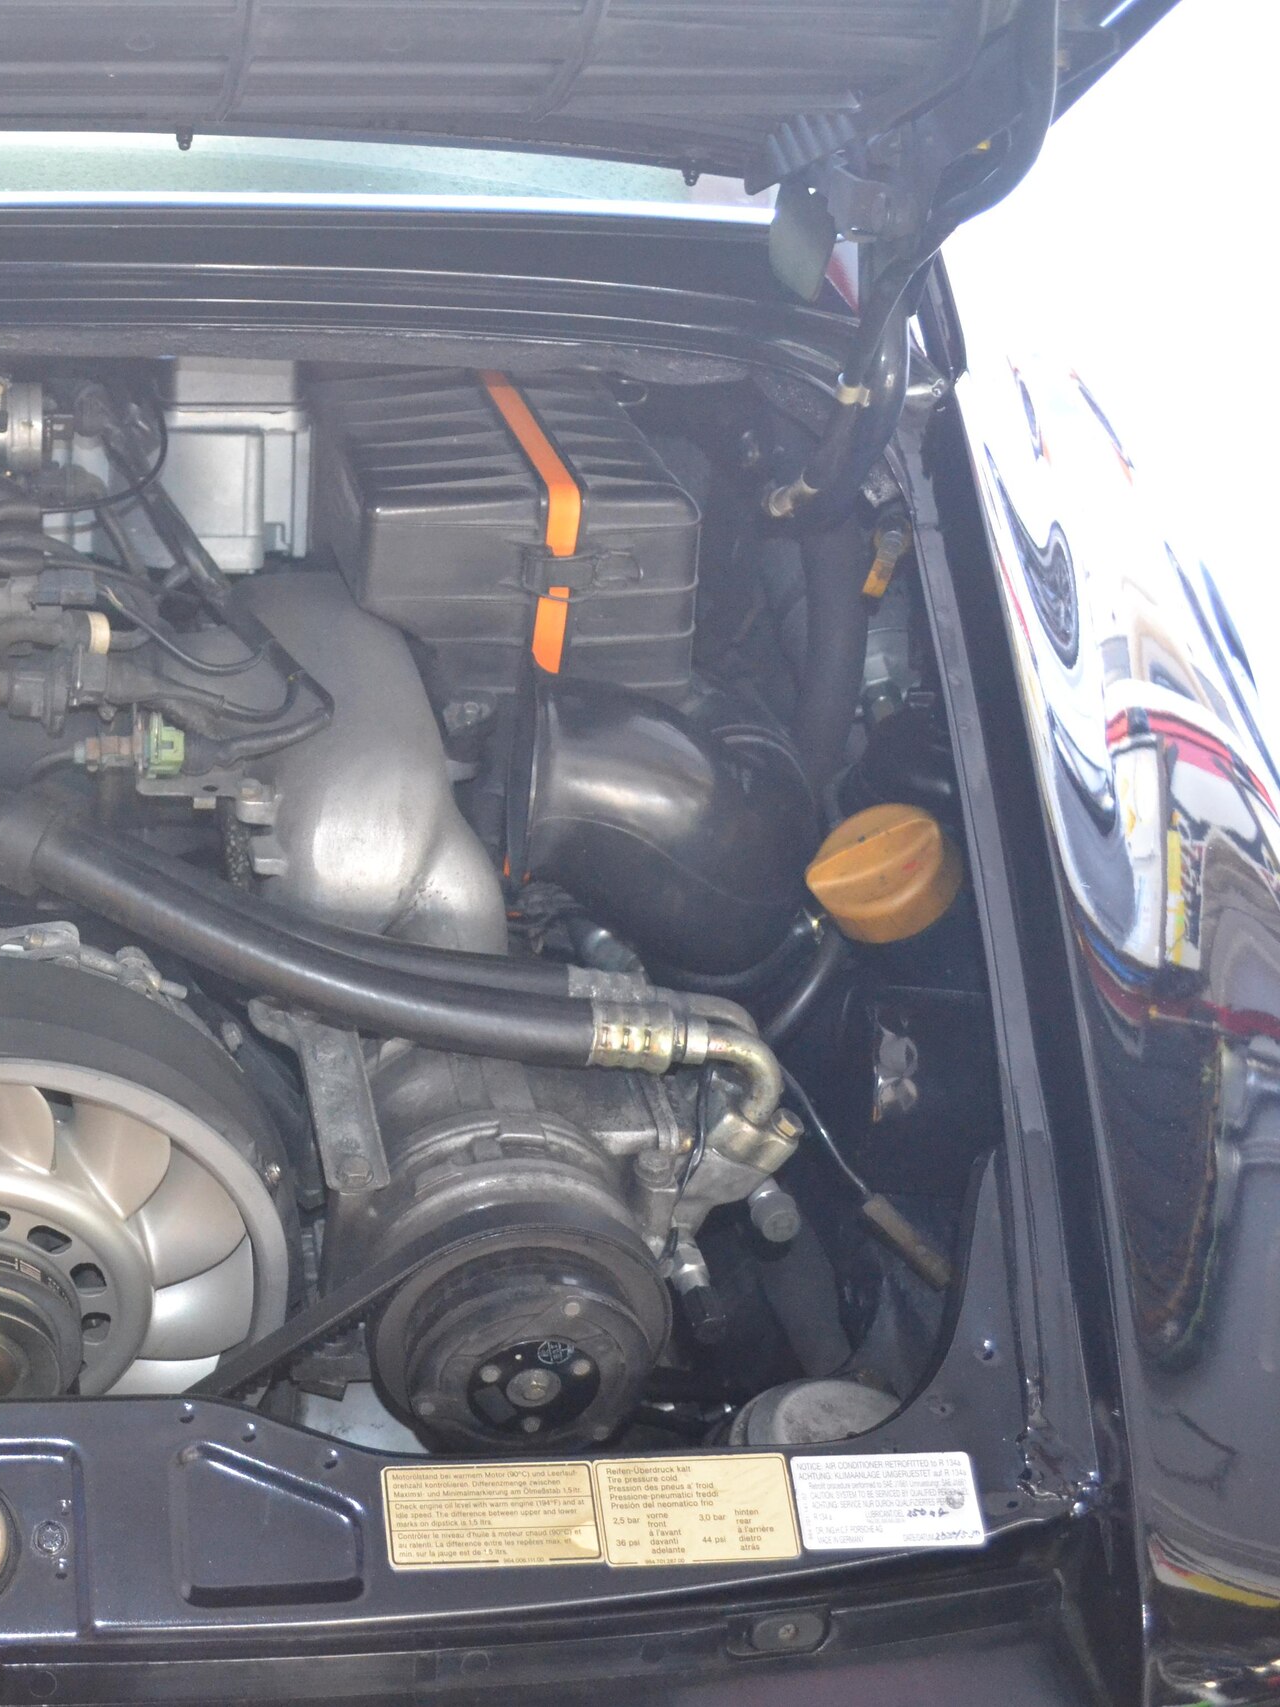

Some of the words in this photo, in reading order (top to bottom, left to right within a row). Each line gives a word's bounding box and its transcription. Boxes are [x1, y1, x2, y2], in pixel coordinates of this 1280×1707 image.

[825, 1462, 836, 1470] AIR
[838, 1461, 883, 1469] CONDITIONER
[885, 1459, 929, 1468] RETROFITTED
[930, 1459, 937, 1467] to
[606, 1465, 674, 1475] Reifen-Überdruck
[510, 1500, 534, 1508] engine
[611, 1502, 640, 1510] Presión
[657, 1500, 698, 1508] neomatico
[613, 1517, 625, 1525] 2,5
[628, 1539, 640, 1547] psi
[714, 1536, 727, 1544] psi
[651, 1546, 685, 1554] adelante
